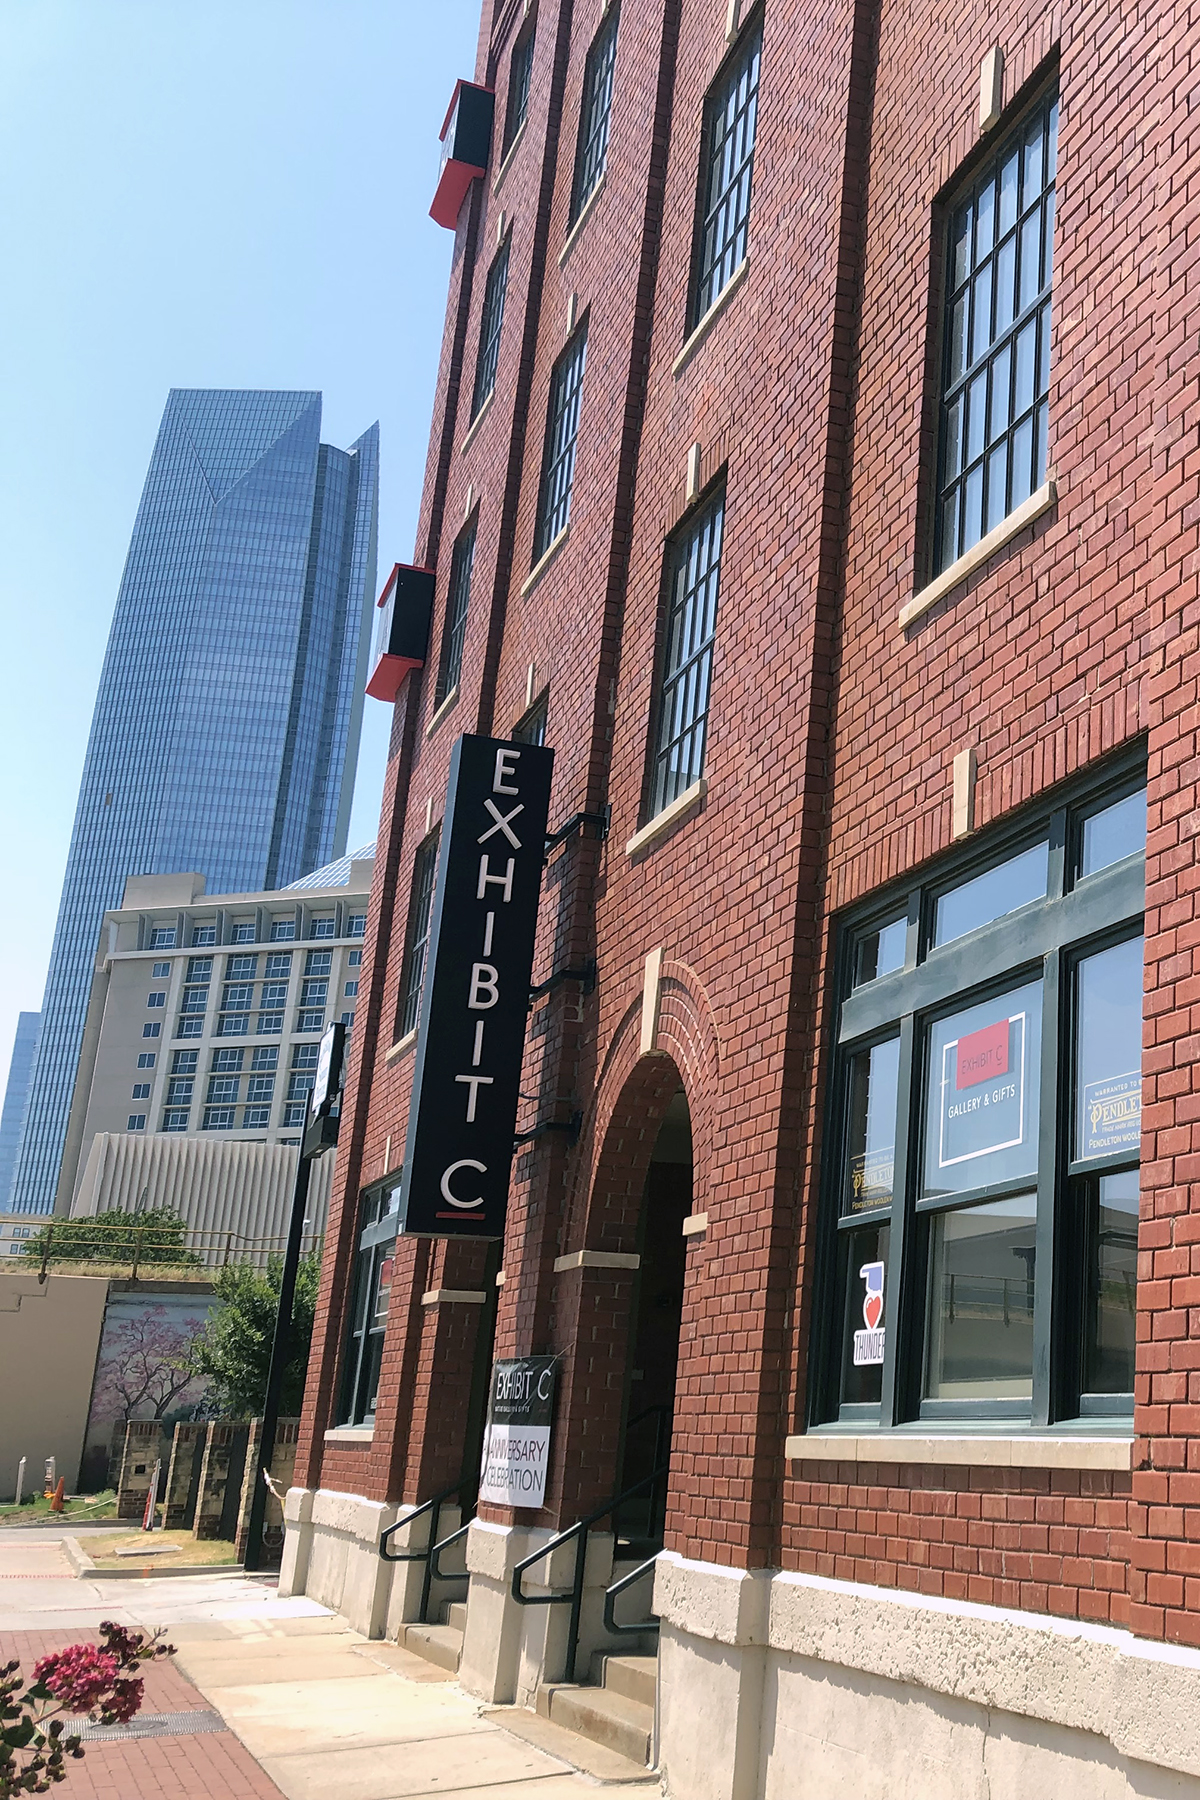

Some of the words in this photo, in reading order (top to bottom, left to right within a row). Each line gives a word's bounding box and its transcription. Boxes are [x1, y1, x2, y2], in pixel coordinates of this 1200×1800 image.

[455, 748, 525, 1123] EXHIBIT
[962, 1049, 993, 1075] EXHIBIT
[996, 1045, 1003, 1062] C
[948, 1096, 982, 1118] GALLERY
[983, 1093, 990, 1106] &
[992, 1083, 1016, 1103] GIFTS
[1094, 1082, 1128, 1096] WARRANTED
[1088, 1135, 1122, 1149] PENDLETON
[440, 1158, 488, 1209] C
[496, 1371, 534, 1400] EXHIBIT
[537, 1369, 552, 1400] C
[486, 1466, 543, 1491] CELEBRATION
